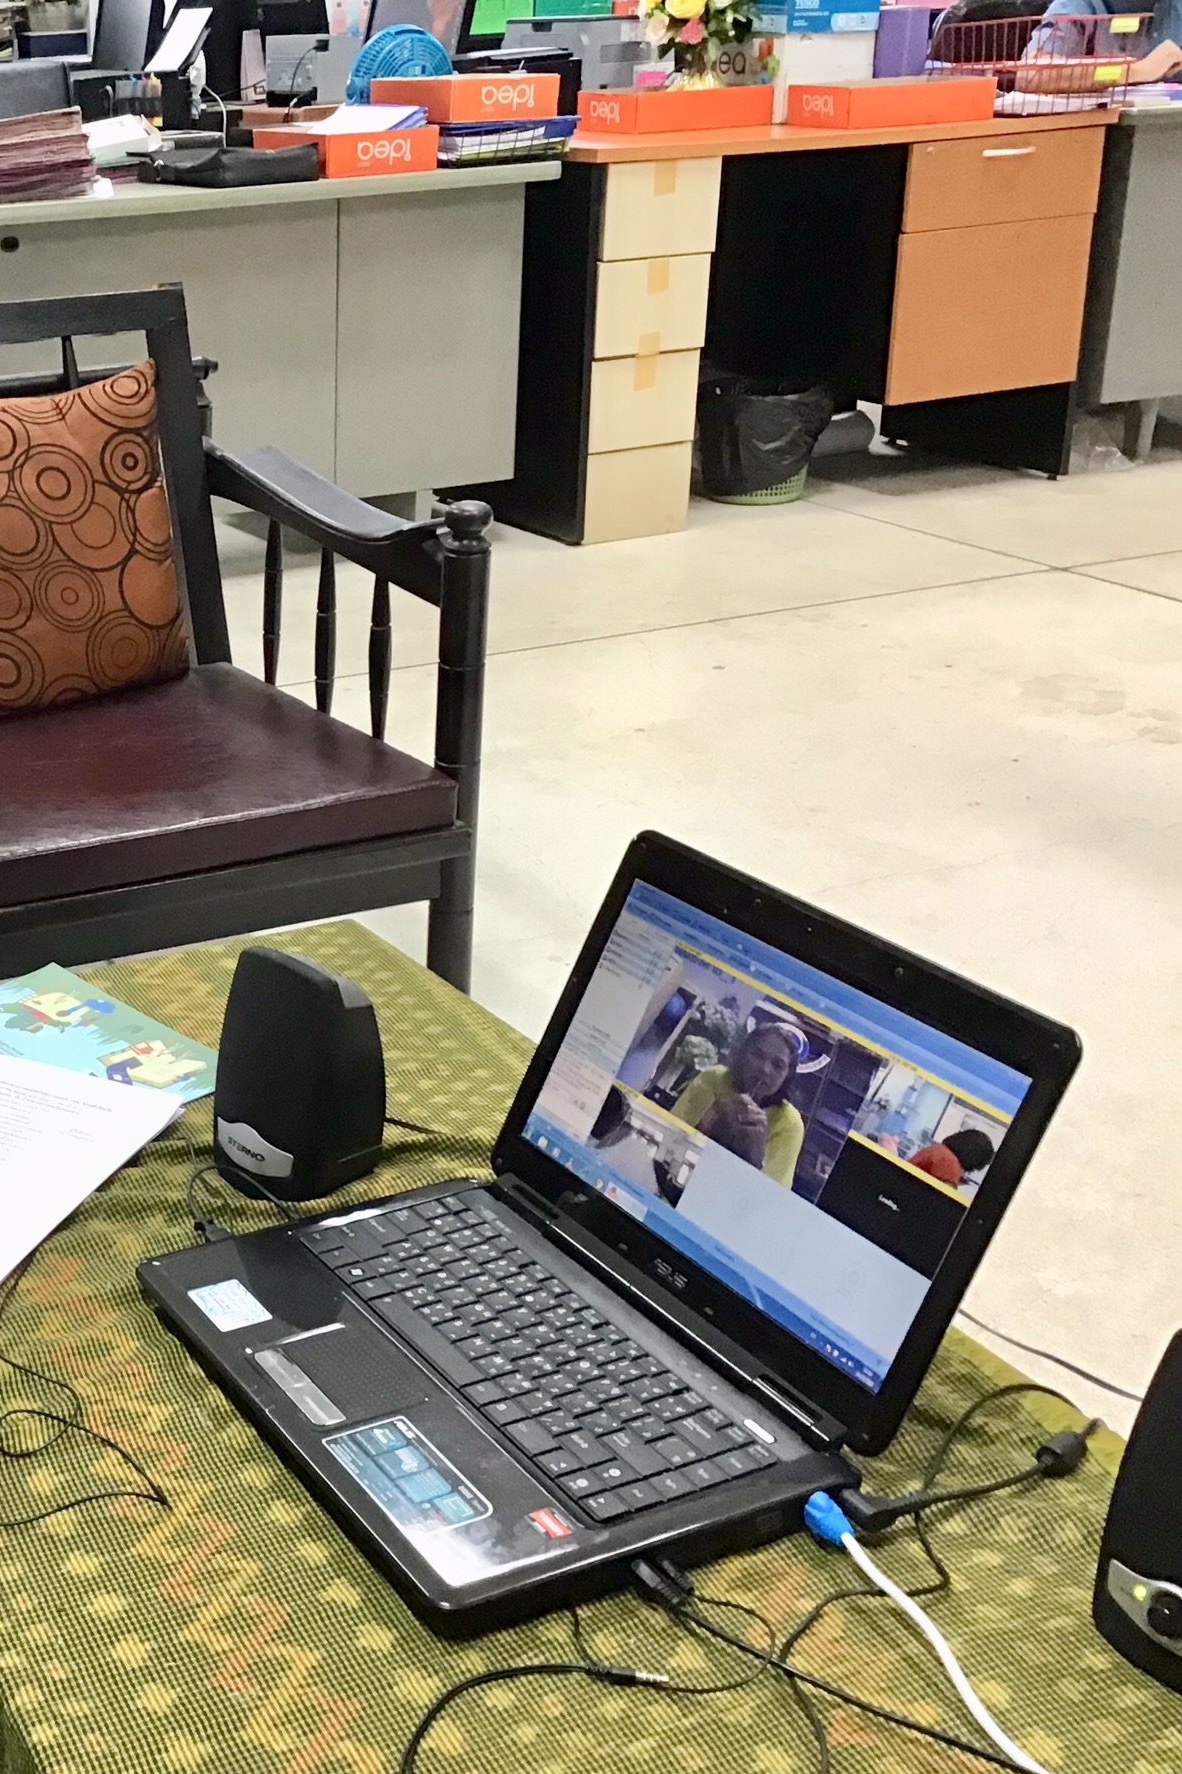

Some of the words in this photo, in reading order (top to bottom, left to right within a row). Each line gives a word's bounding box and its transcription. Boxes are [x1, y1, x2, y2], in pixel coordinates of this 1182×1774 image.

[480, 84, 535, 112] idea
[802, 93, 835, 118] idea
[589, 100, 620, 124] idea
[357, 138, 412, 166] idea
[227, 1136, 266, 1162] STERNO
